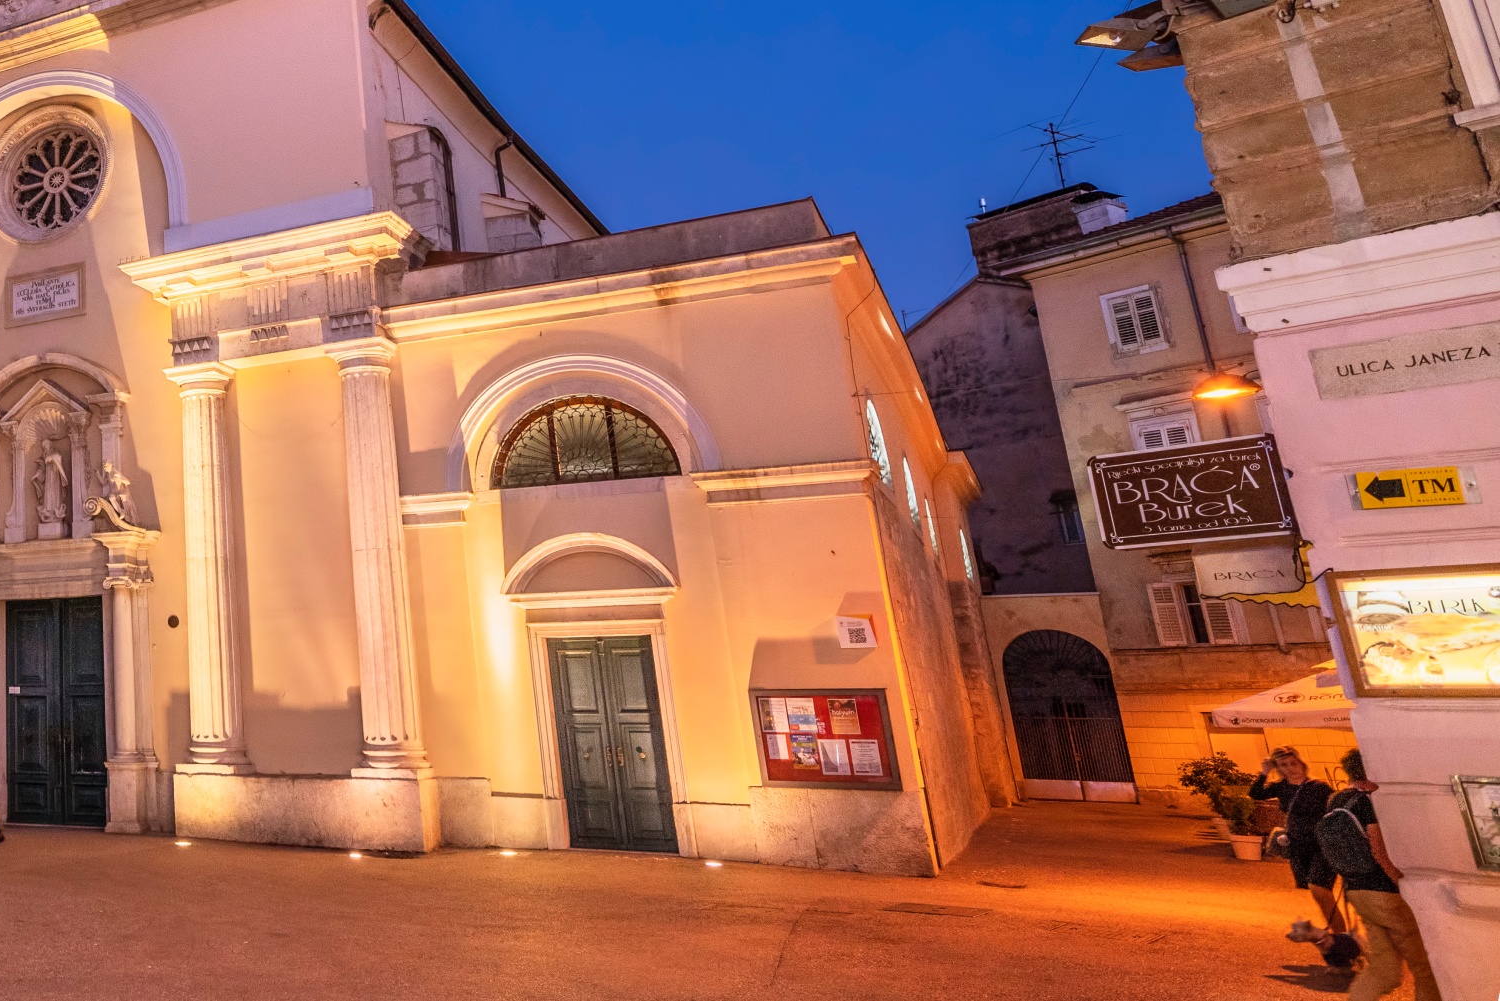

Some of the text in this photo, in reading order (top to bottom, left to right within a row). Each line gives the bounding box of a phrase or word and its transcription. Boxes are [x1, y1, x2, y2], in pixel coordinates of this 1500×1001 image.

[1336, 345, 1492, 378] ULICA JANEZA
[1411, 476, 1458, 495] TM
[1138, 494, 1248, 524] Burek
